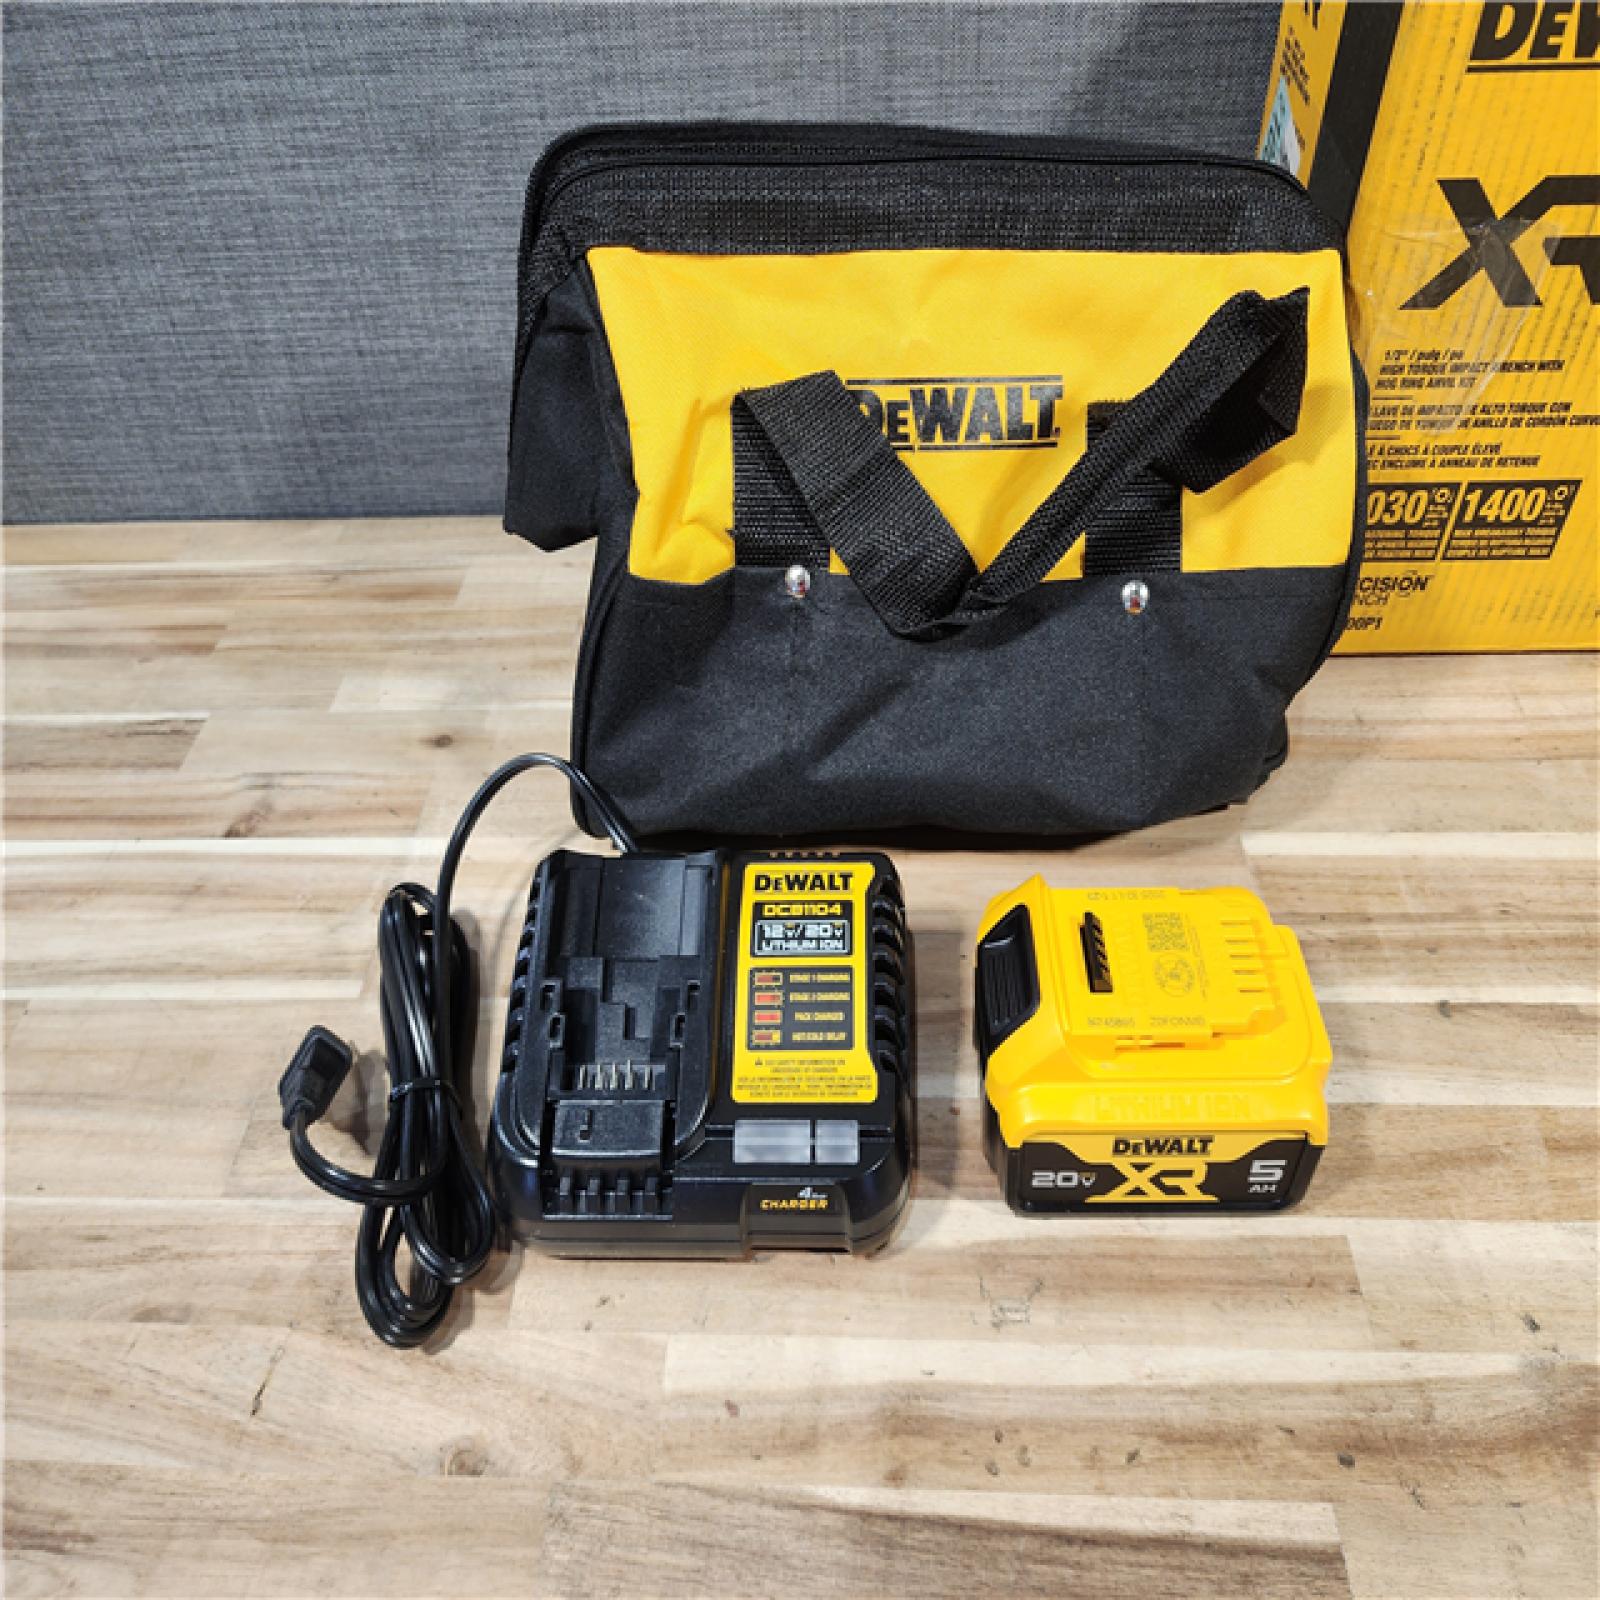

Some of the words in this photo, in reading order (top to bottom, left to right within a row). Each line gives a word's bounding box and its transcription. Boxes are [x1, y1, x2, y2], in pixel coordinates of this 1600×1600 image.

[1367, 488, 1429, 525] 030
[1463, 488, 1548, 523] 1400
[1359, 575, 1431, 592] CISION
[754, 873, 854, 891] DEWALT
[1112, 1136, 1215, 1155] DEWALT
[1085, 1161, 1221, 1204] XR
[1247, 1159, 1288, 1183] 5
